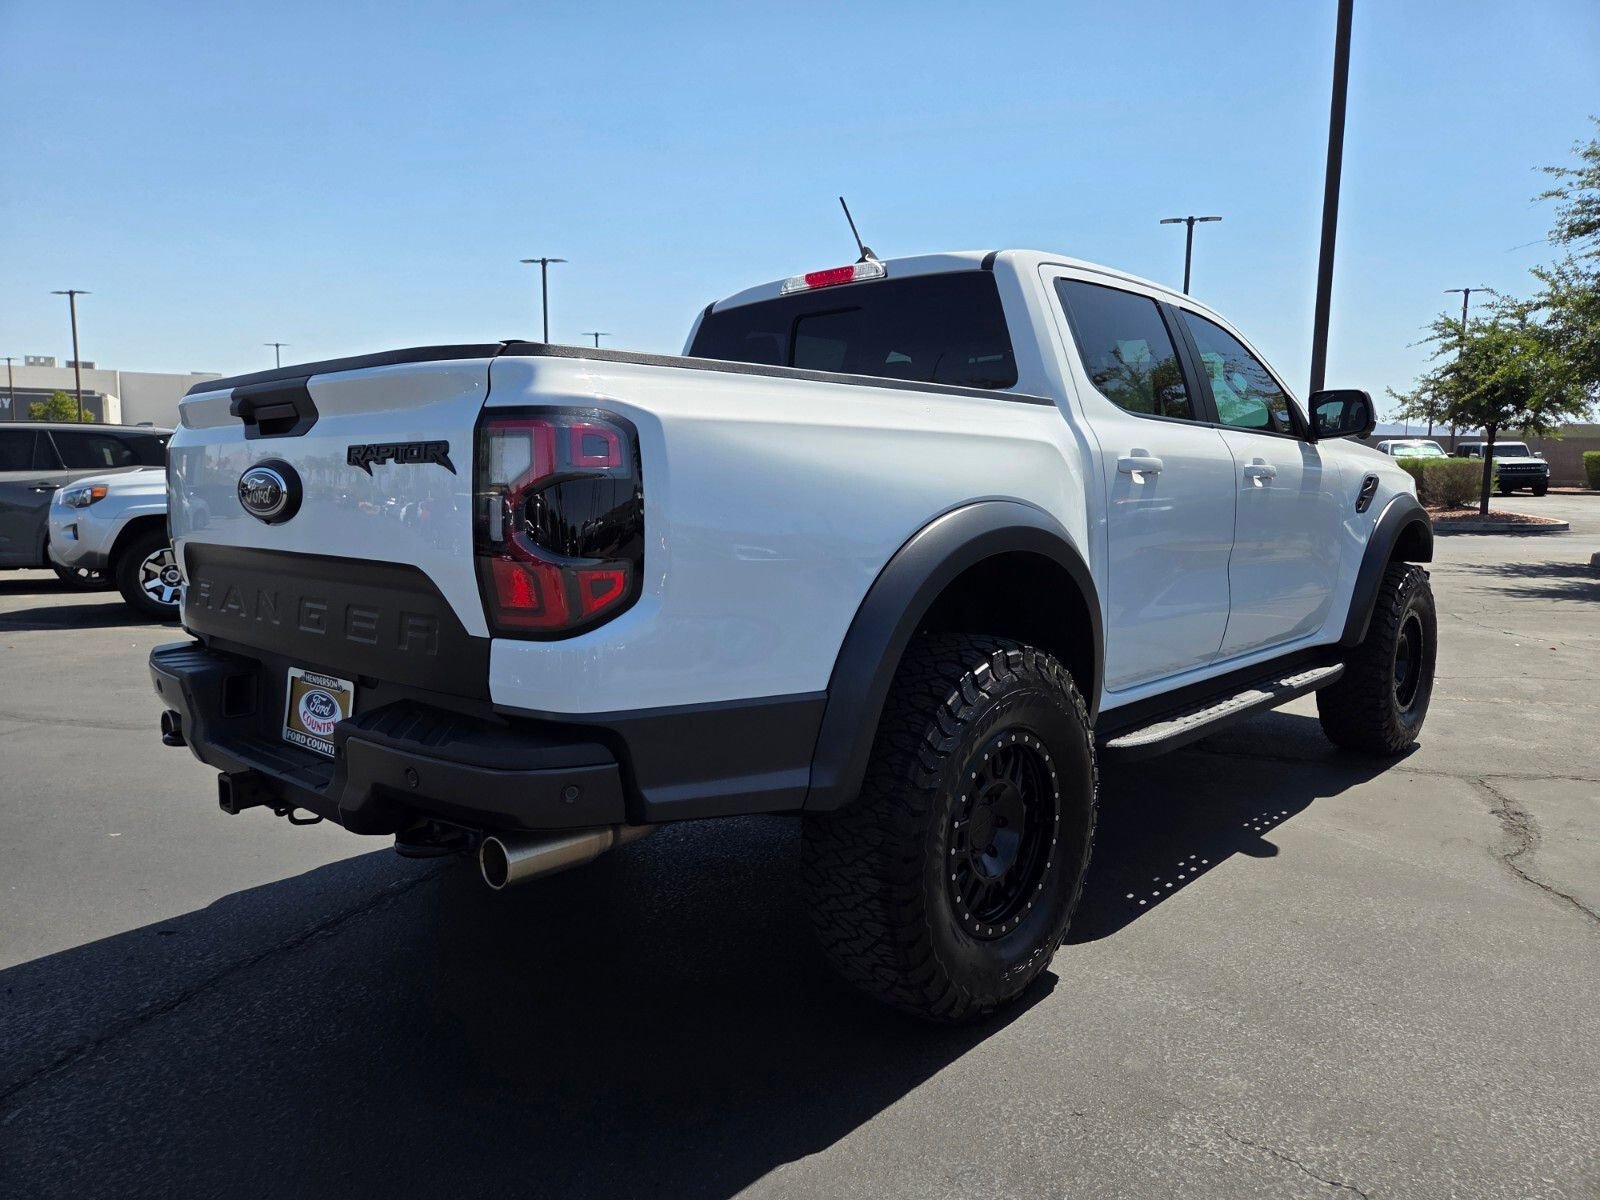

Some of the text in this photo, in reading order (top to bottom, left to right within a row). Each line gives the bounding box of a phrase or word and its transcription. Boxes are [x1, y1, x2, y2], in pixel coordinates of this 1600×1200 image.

[347, 440, 457, 476] RAPTOR
[246, 478, 272, 504] Ford
[194, 578, 440, 656] RANGER
[305, 674, 338, 688] HENDERSON
[309, 694, 332, 716] Ford
[286, 730, 306, 744] FORD
